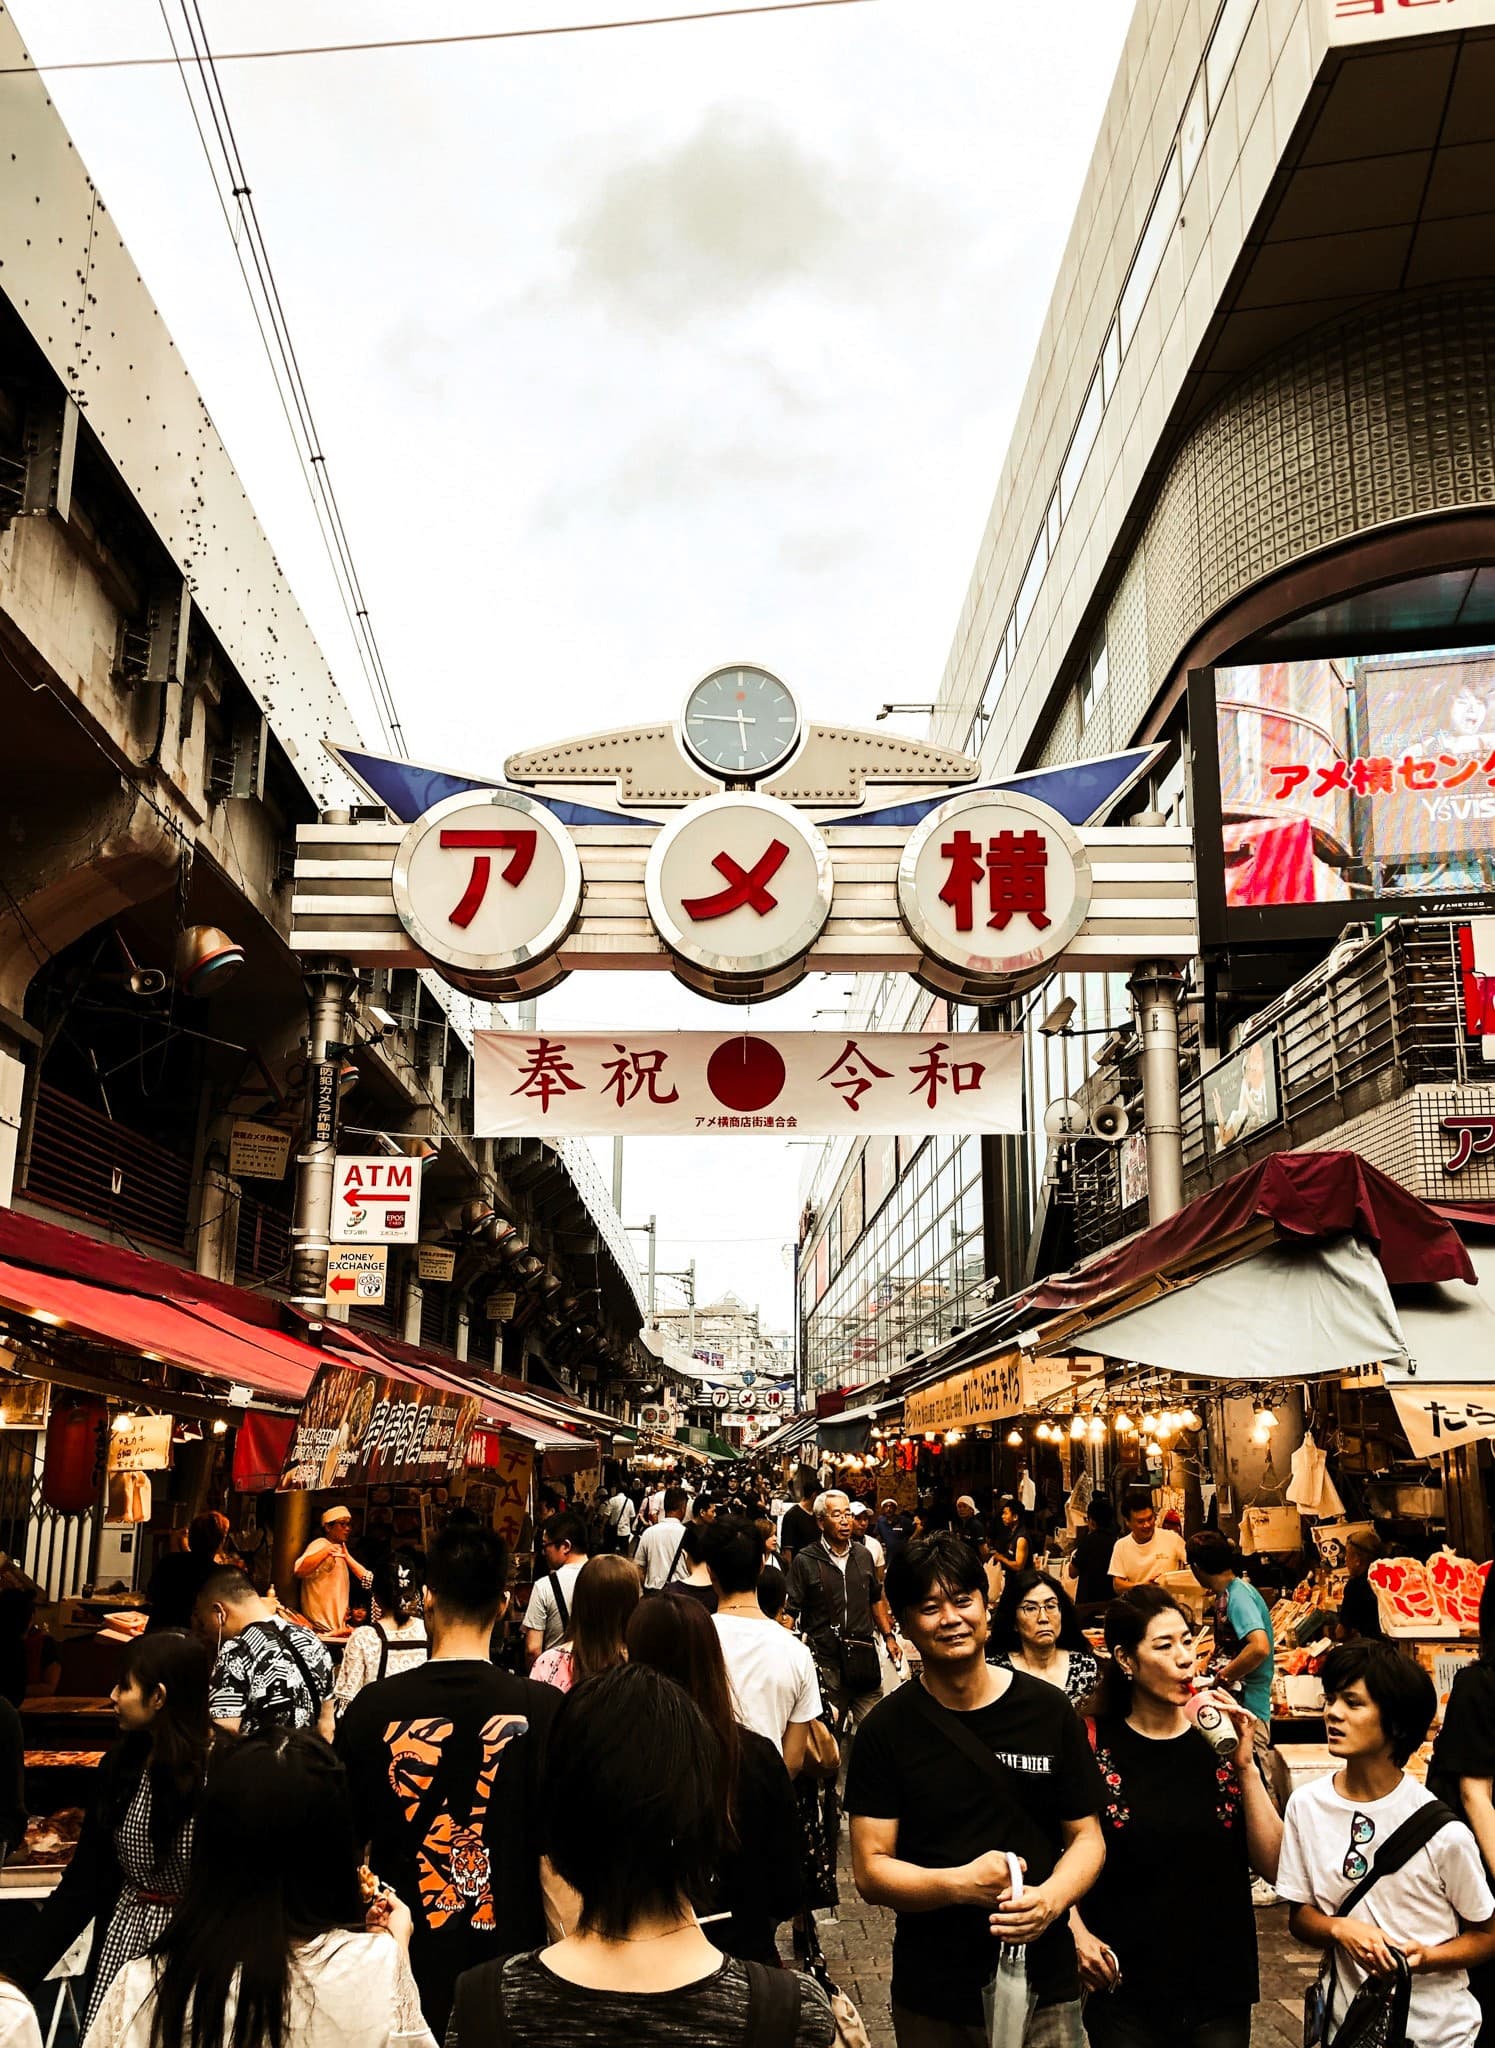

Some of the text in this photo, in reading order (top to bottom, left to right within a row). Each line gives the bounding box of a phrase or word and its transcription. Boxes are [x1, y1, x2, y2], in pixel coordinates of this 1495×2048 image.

[439, 829, 1053, 932] アメ横
[510, 1037, 986, 1114] 奉祝 令和
[316, 1067, 333, 1141] 防犯カメラ作動中
[694, 1115, 798, 1129] アメ横商店街連合会
[343, 1165, 412, 1187] ATM
[386, 1214, 404, 1222] EPOS
[328, 1262, 385, 1271] EXCHANGE
[340, 1253, 375, 1261] MONEY
[1369, 1563, 1435, 1618] かに
